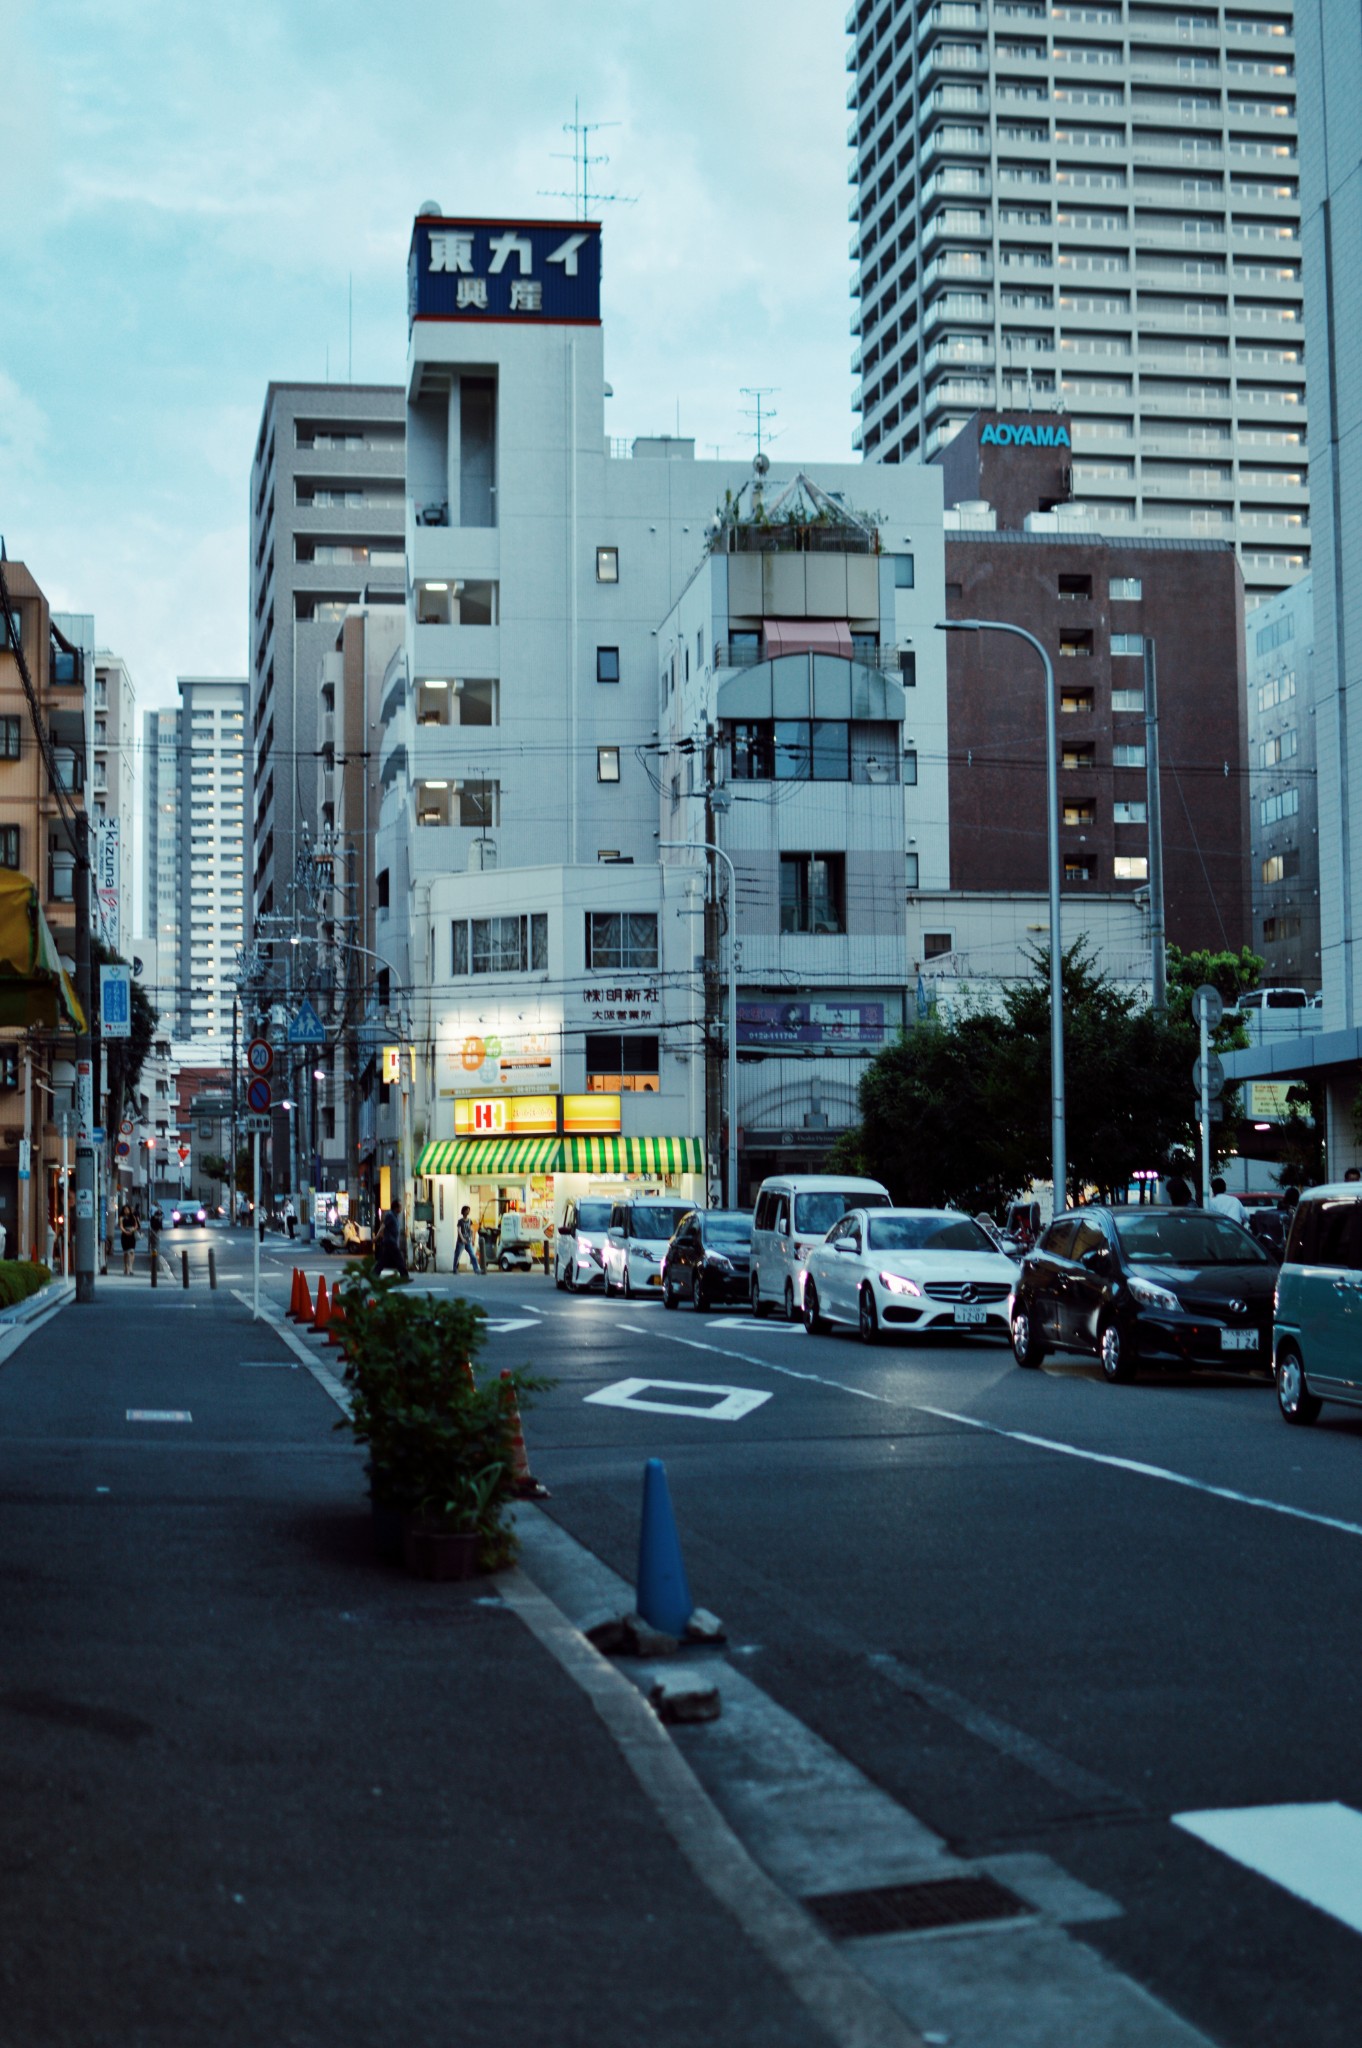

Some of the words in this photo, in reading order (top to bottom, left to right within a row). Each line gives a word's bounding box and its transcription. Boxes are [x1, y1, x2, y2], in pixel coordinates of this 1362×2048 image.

[427, 229, 590, 276] 東カイ
[456, 277, 542, 311] 興産
[980, 423, 1071, 448] AOYAMA
[105, 831, 118, 888] kizuna
[583, 987, 660, 1003] (株)明新社
[253, 1049, 267, 1065] 20
